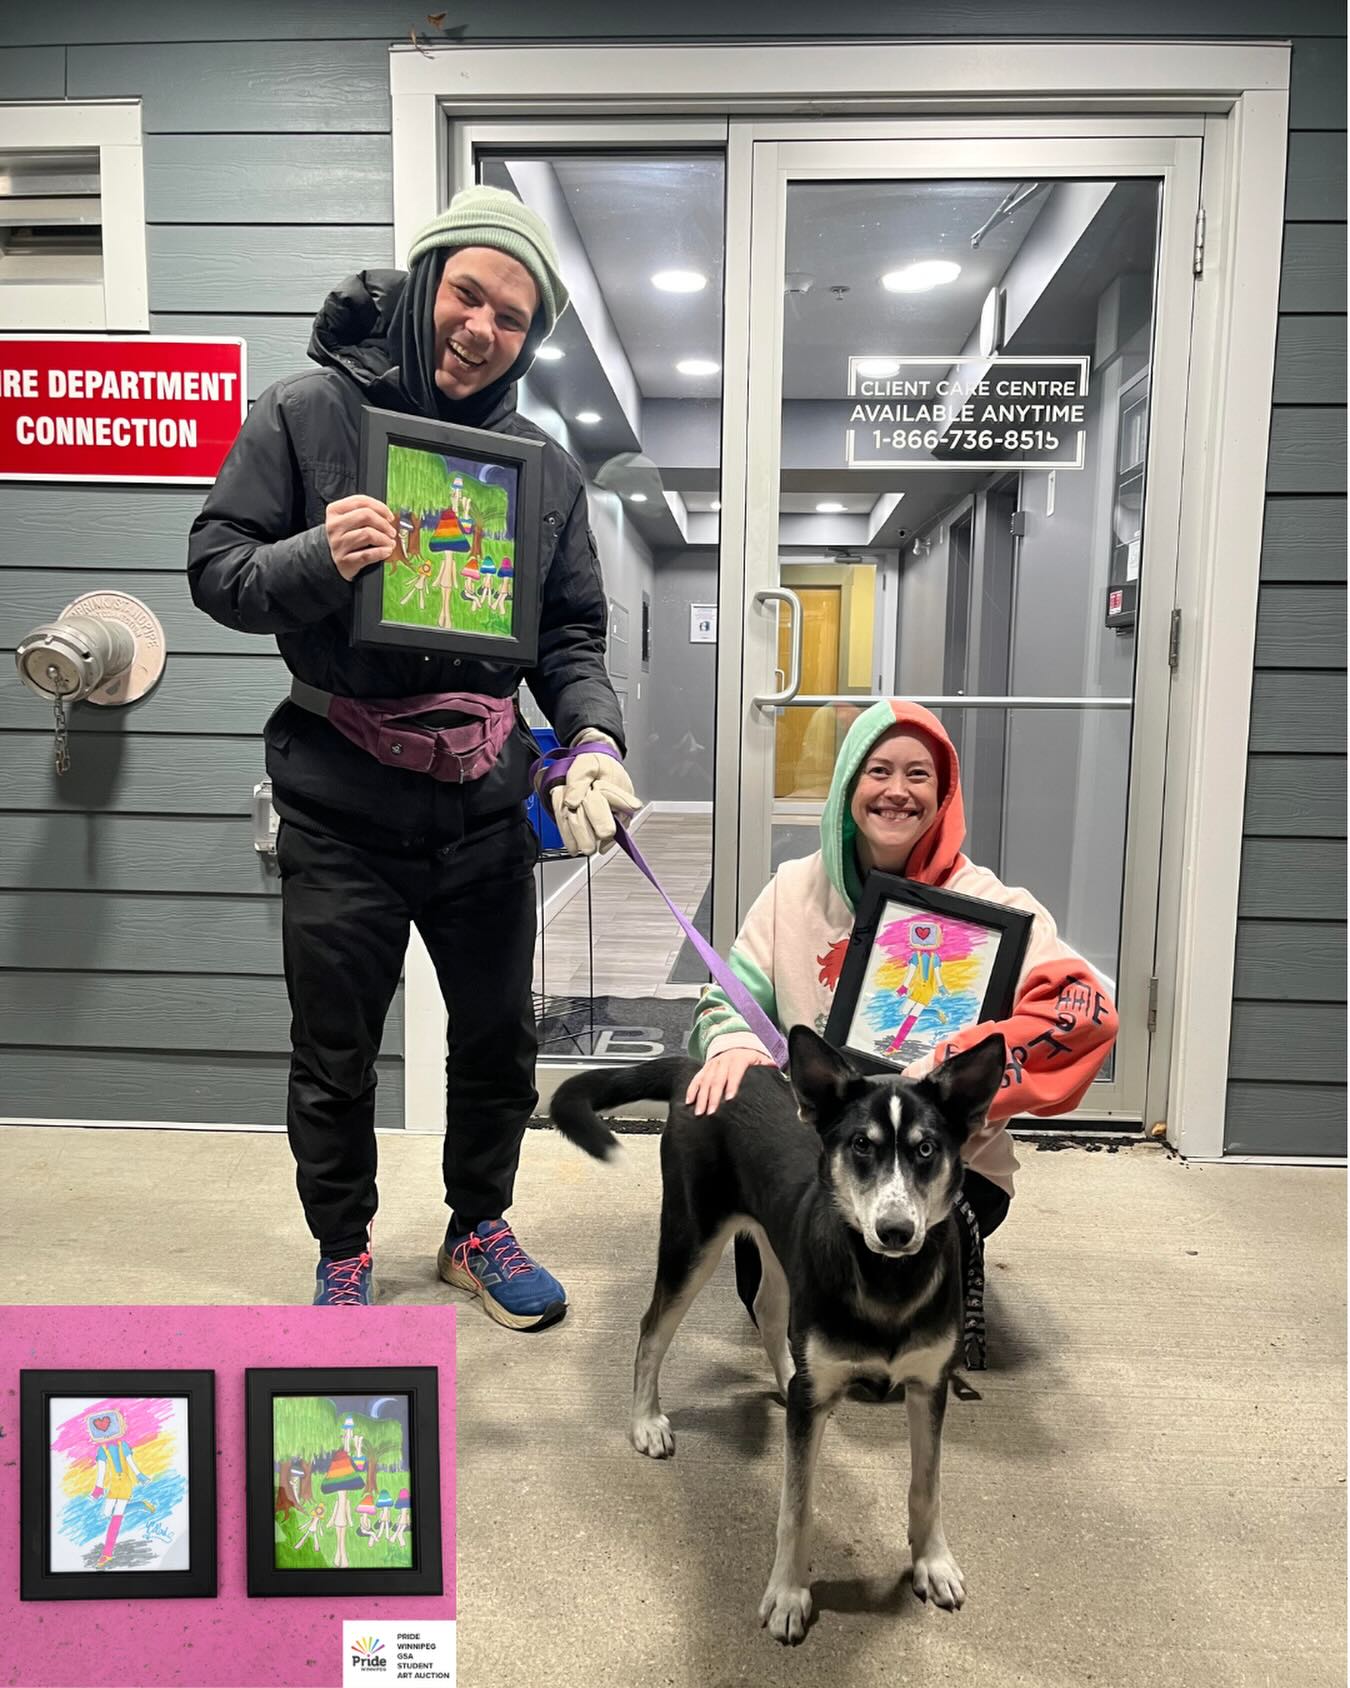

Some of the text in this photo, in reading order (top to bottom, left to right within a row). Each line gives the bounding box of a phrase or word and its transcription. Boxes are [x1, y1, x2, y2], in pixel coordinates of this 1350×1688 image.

[47, 369, 238, 401] DEPARTMENT
[860, 380, 1076, 397] CLIENT CARE CENTRE
[849, 404, 1085, 423] AVAILABLE ANYTIME
[15, 415, 198, 448] CONNECTION
[872, 429, 1060, 450] 1-866-736-8515
